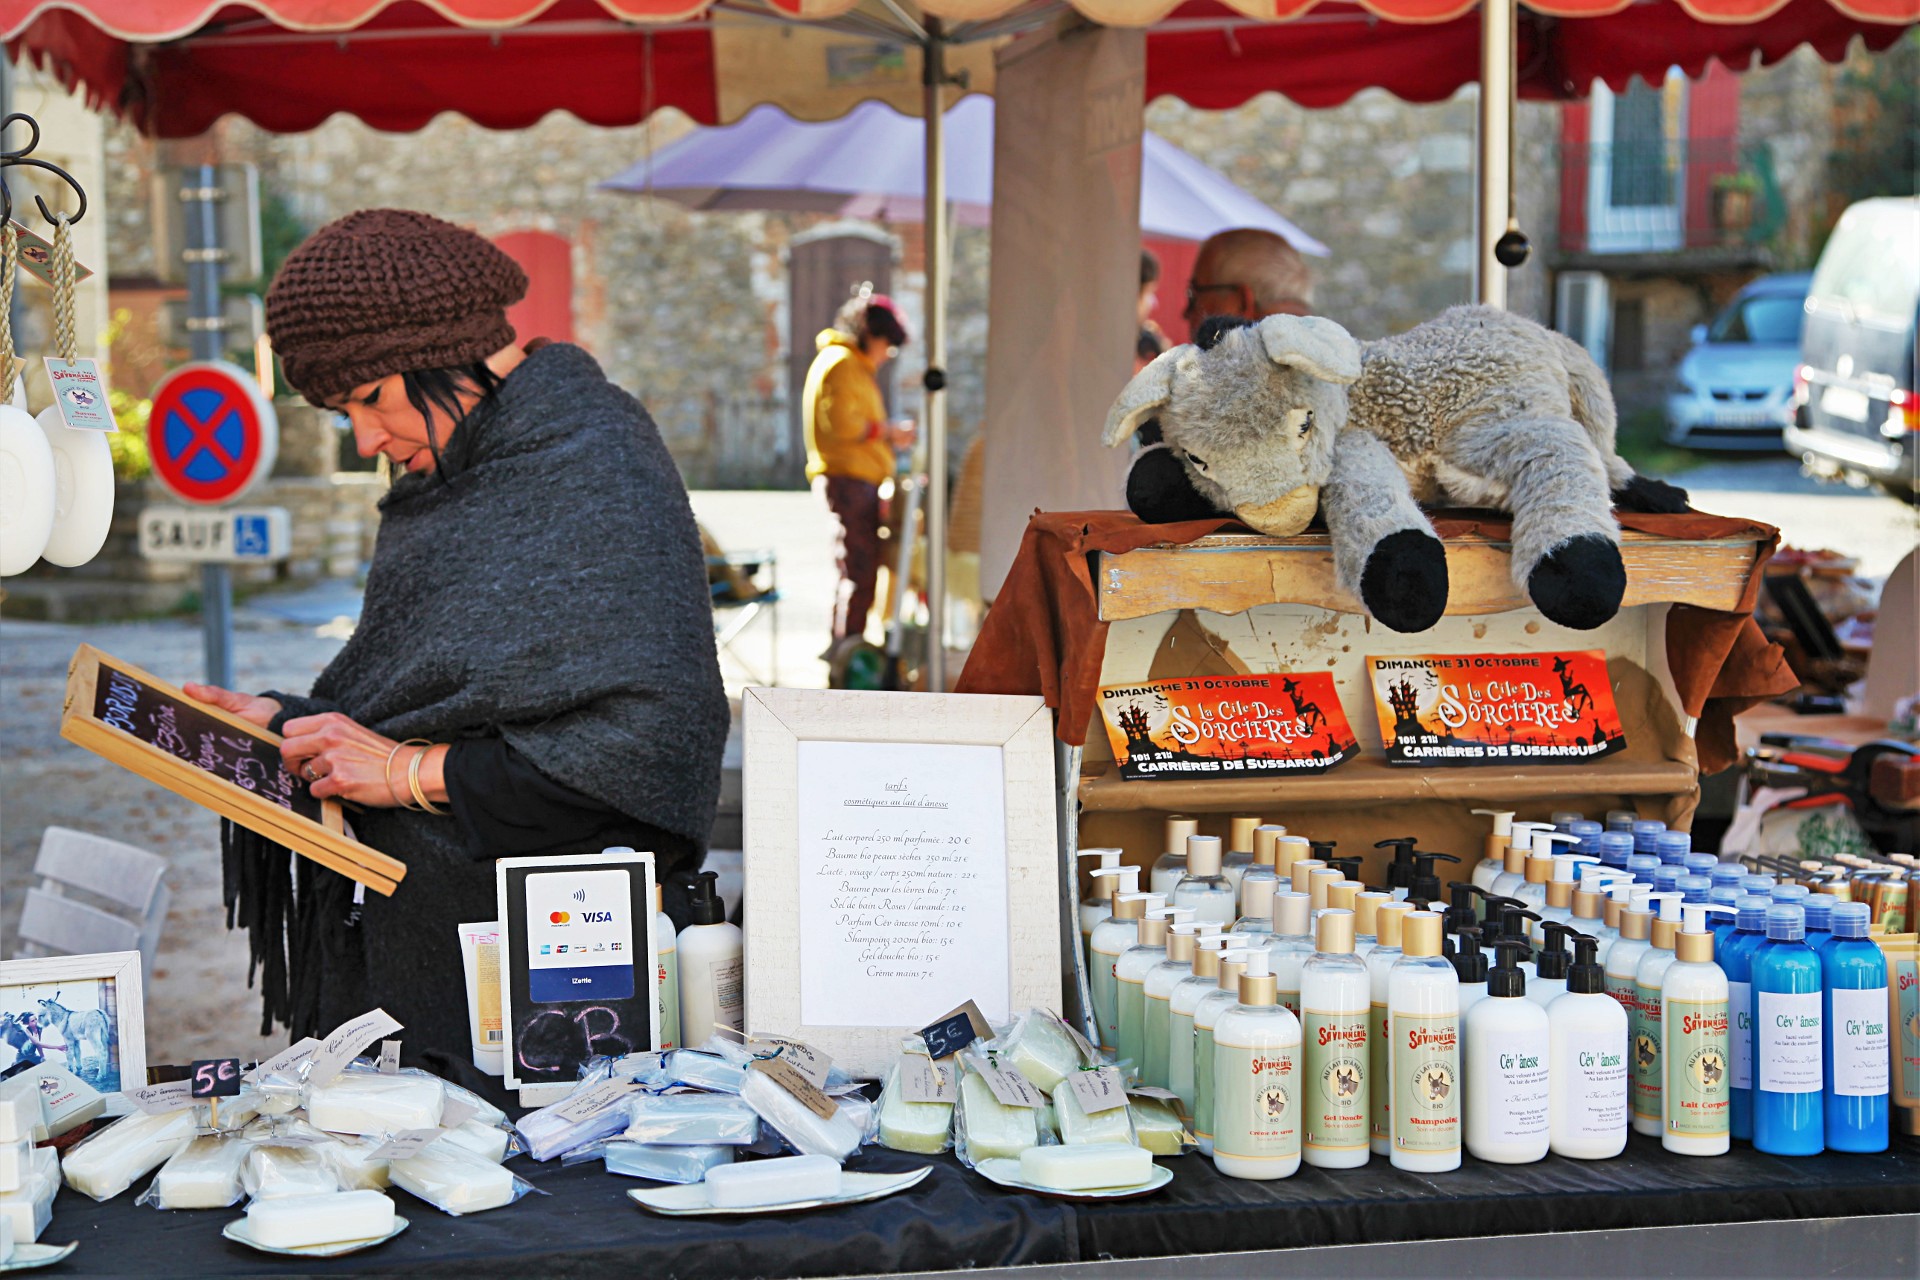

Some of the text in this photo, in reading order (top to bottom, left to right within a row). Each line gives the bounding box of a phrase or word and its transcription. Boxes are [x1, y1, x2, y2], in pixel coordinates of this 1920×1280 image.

[148, 520, 226, 548] SAUF
[1375, 657, 1540, 670] DIMANCHE 31 OCTOBRE
[1103, 679, 1270, 699] DIMANCHE 31 OCTOBRE
[1403, 741, 1608, 758] CARRIÈRES DE SUSSARGUES
[1137, 752, 1344, 773] CARRIÈRES DE SUSSARGUES
[844, 798, 888, 808] cosmétiques
[903, 794, 915, 806] lait
[822, 830, 842, 841] Lait
[845, 829, 879, 844] corporel
[894, 830, 908, 842] ml
[826, 848, 857, 859] Baume
[860, 847, 871, 859] bio
[873, 852, 895, 863] peaux
[942, 850, 956, 862] ml
[850, 869, 872, 879] visage
[880, 870, 899, 880] corps
[902, 865, 930, 878] 250ml
[839, 881, 870, 893] Baume
[872, 887, 889, 896] pour
[891, 881, 901, 893] les
[903, 881, 924, 894] lèvres
[928, 881, 938, 894] bio
[830, 897, 850, 908] Sel
[846, 897, 857, 909] de
[859, 897, 875, 909] bain
[878, 899, 905, 910] Roses
[580, 911, 612, 923] VISA
[836, 914, 871, 929] Parfum
[844, 930, 890, 946] Shampoing
[893, 931, 924, 944] 200ml
[940, 938, 948, 946] 15
[858, 947, 887, 962] Gel
[878, 947, 904, 960] douche
[908, 948, 918, 960] bio
[866, 965, 893, 977] Crème
[518, 1006, 633, 1071] CB
[928, 1021, 965, 1052] 5€
[196, 1060, 237, 1094] 5€
